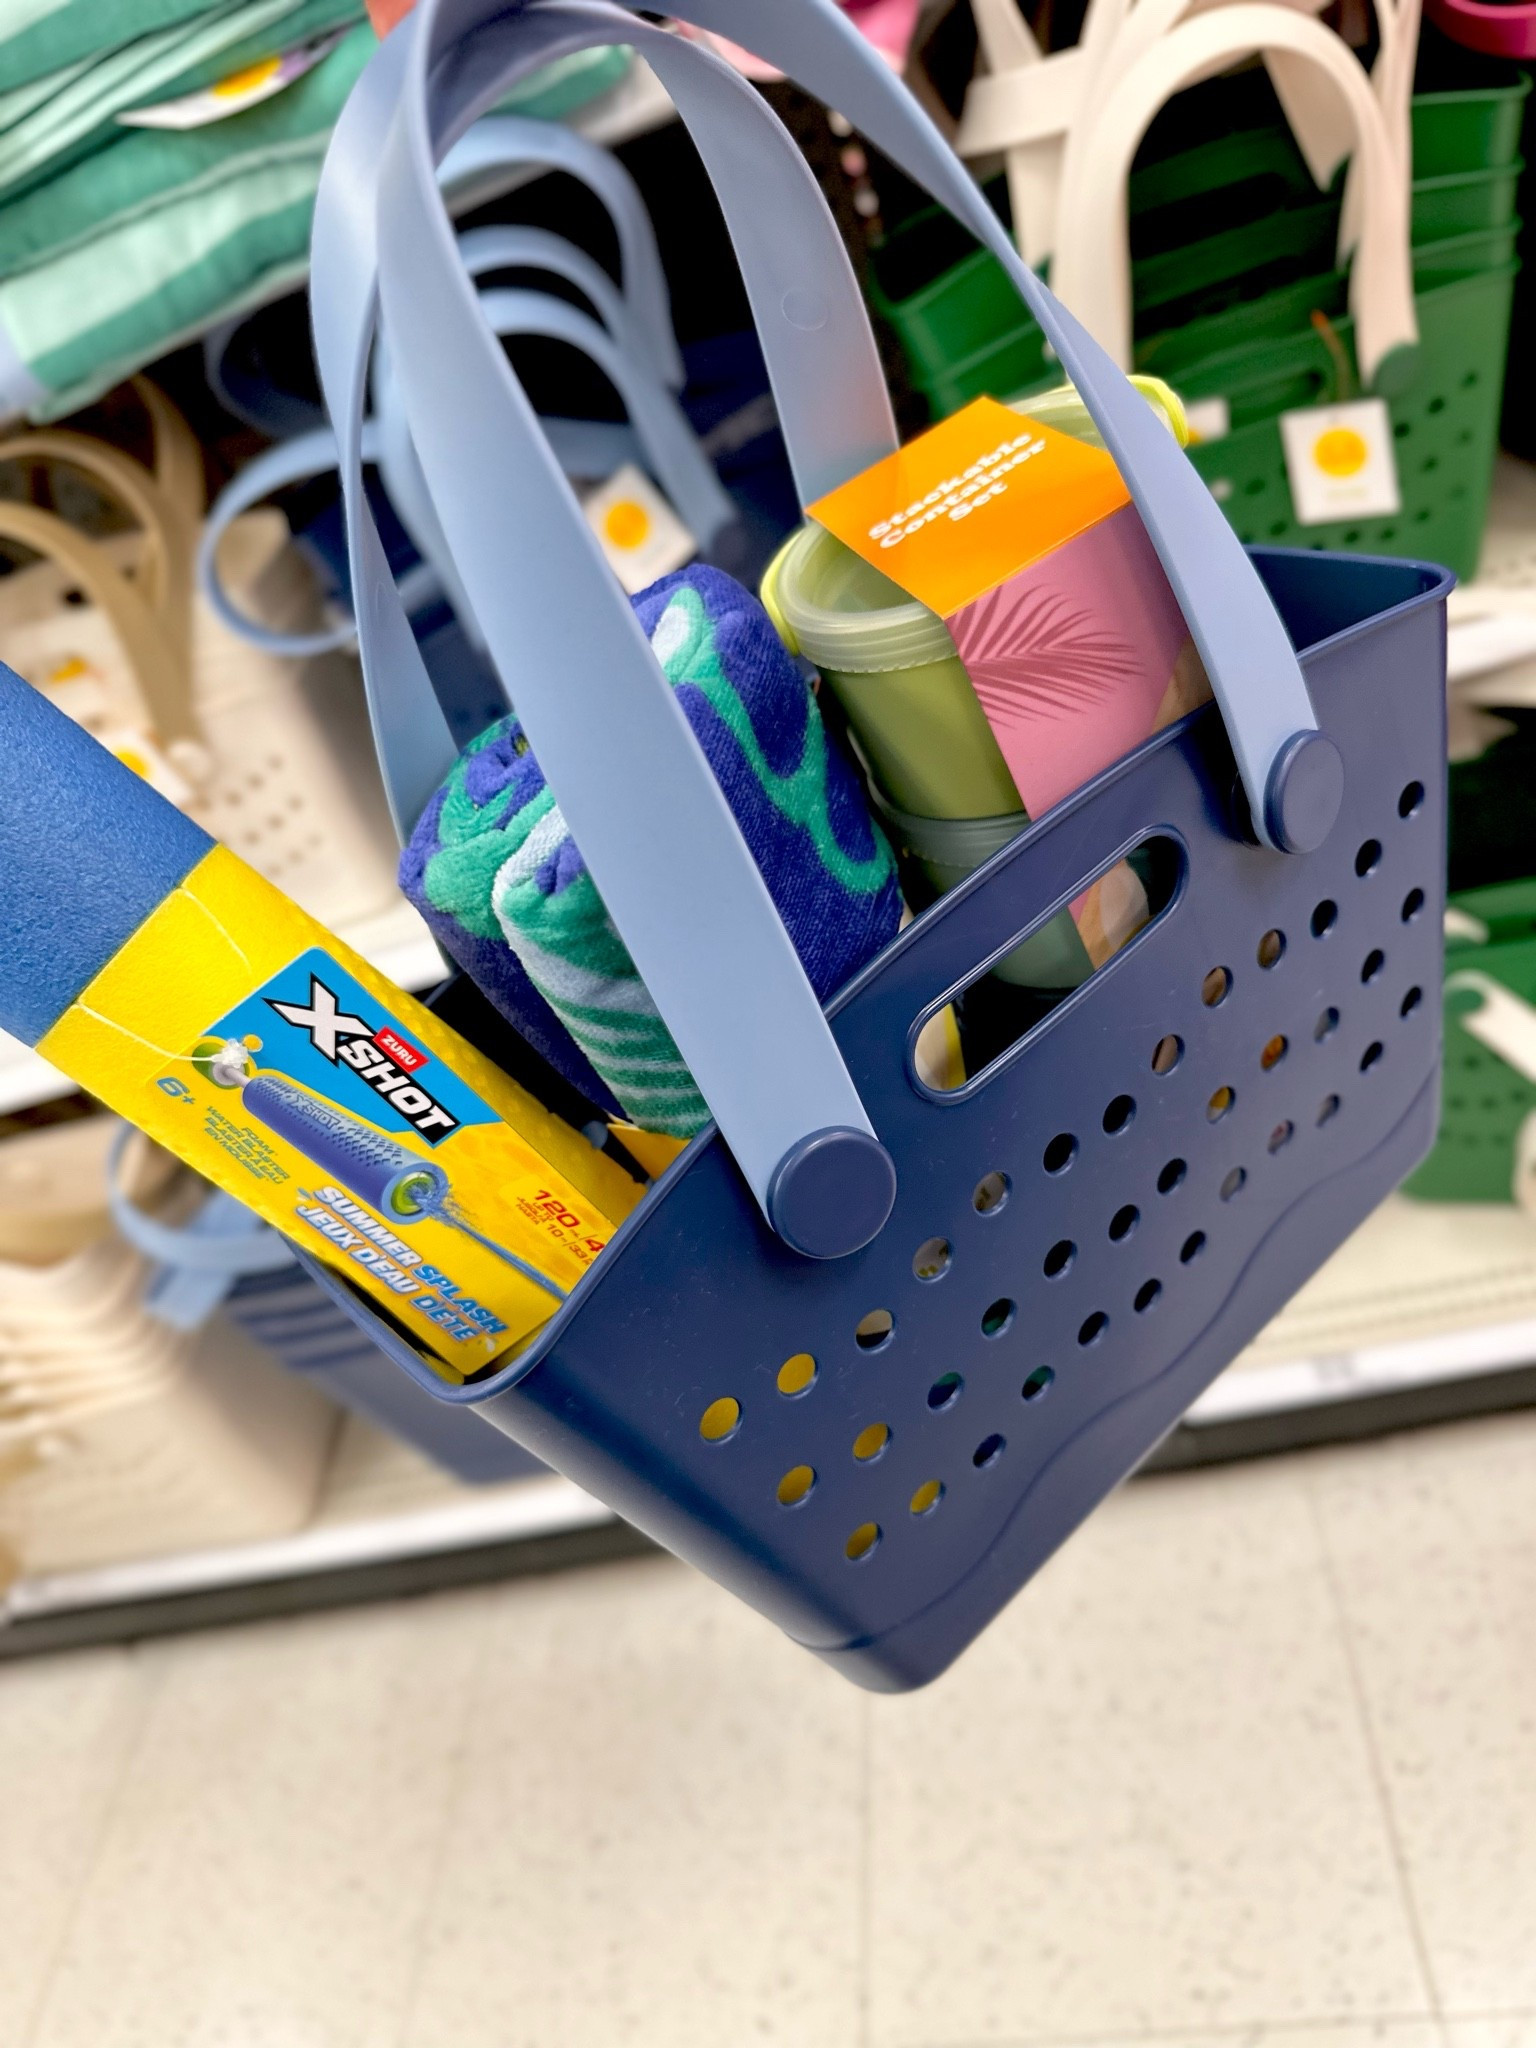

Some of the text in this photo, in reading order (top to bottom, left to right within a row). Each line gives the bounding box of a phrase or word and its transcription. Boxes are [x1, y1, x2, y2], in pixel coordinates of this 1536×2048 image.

[868, 432, 1032, 540] Stackable
[880, 438, 1046, 549] Container
[948, 481, 1008, 522] Set
[382, 1034, 417, 1066] ZURU
[157, 1077, 195, 1104] 6+
[205, 1117, 253, 1158] BLASTER
[259, 1164, 284, 1184] EAU
[206, 1106, 290, 1179] WATER BLASTER
[296, 1205, 364, 1250] JEUX
[350, 1247, 420, 1294] D'EAU
[313, 1186, 508, 1334] SUMMER SPLASH
